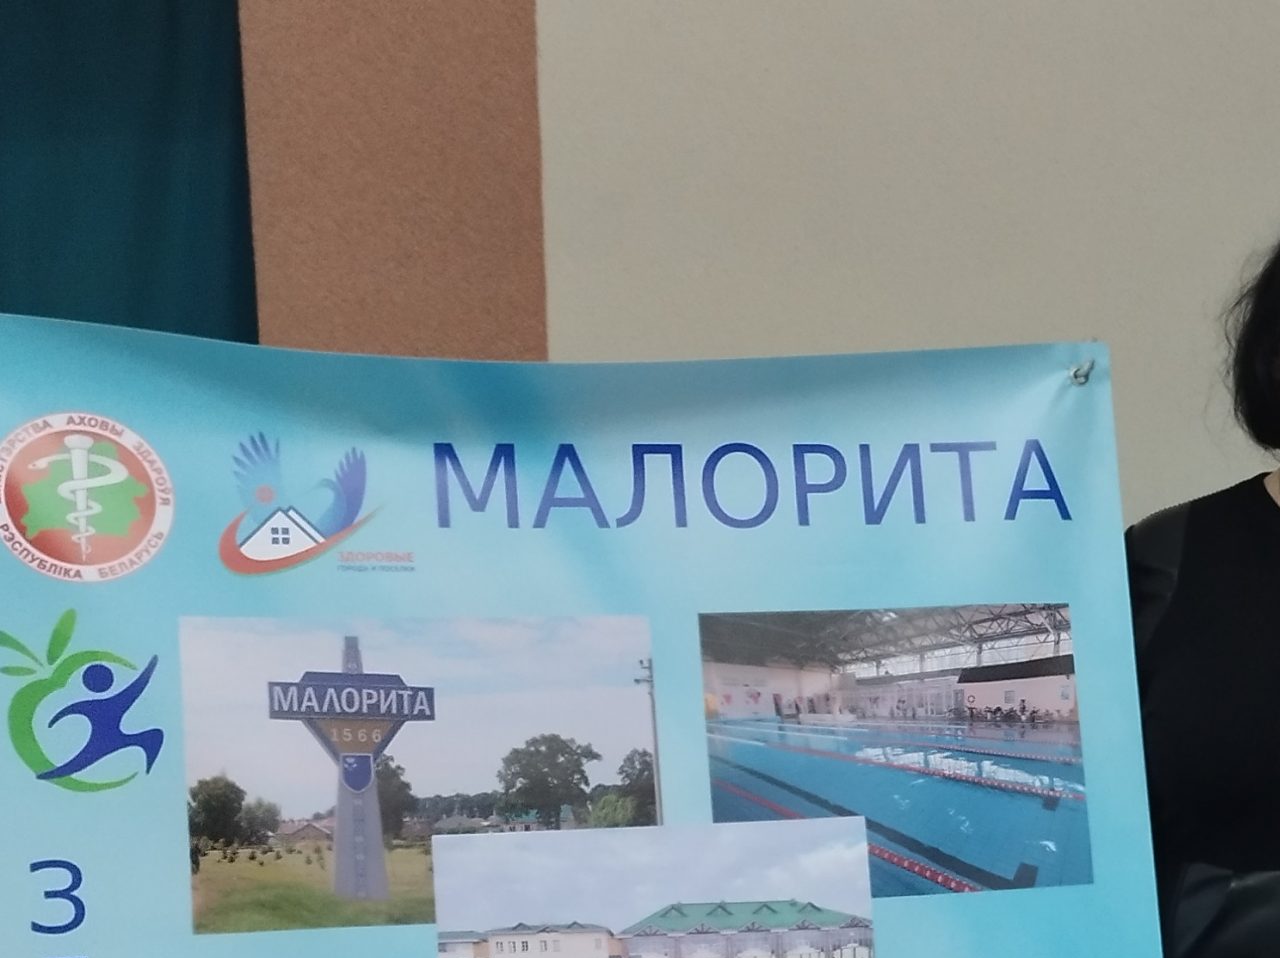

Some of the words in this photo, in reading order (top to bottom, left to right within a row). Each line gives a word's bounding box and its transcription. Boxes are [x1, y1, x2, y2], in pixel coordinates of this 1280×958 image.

[66, 415, 125, 438] АХОВЫ
[432, 437, 1074, 529] МАЛОРИТА
[272, 685, 432, 717] МАЛОРИТА
[330, 725, 383, 745] 1566
